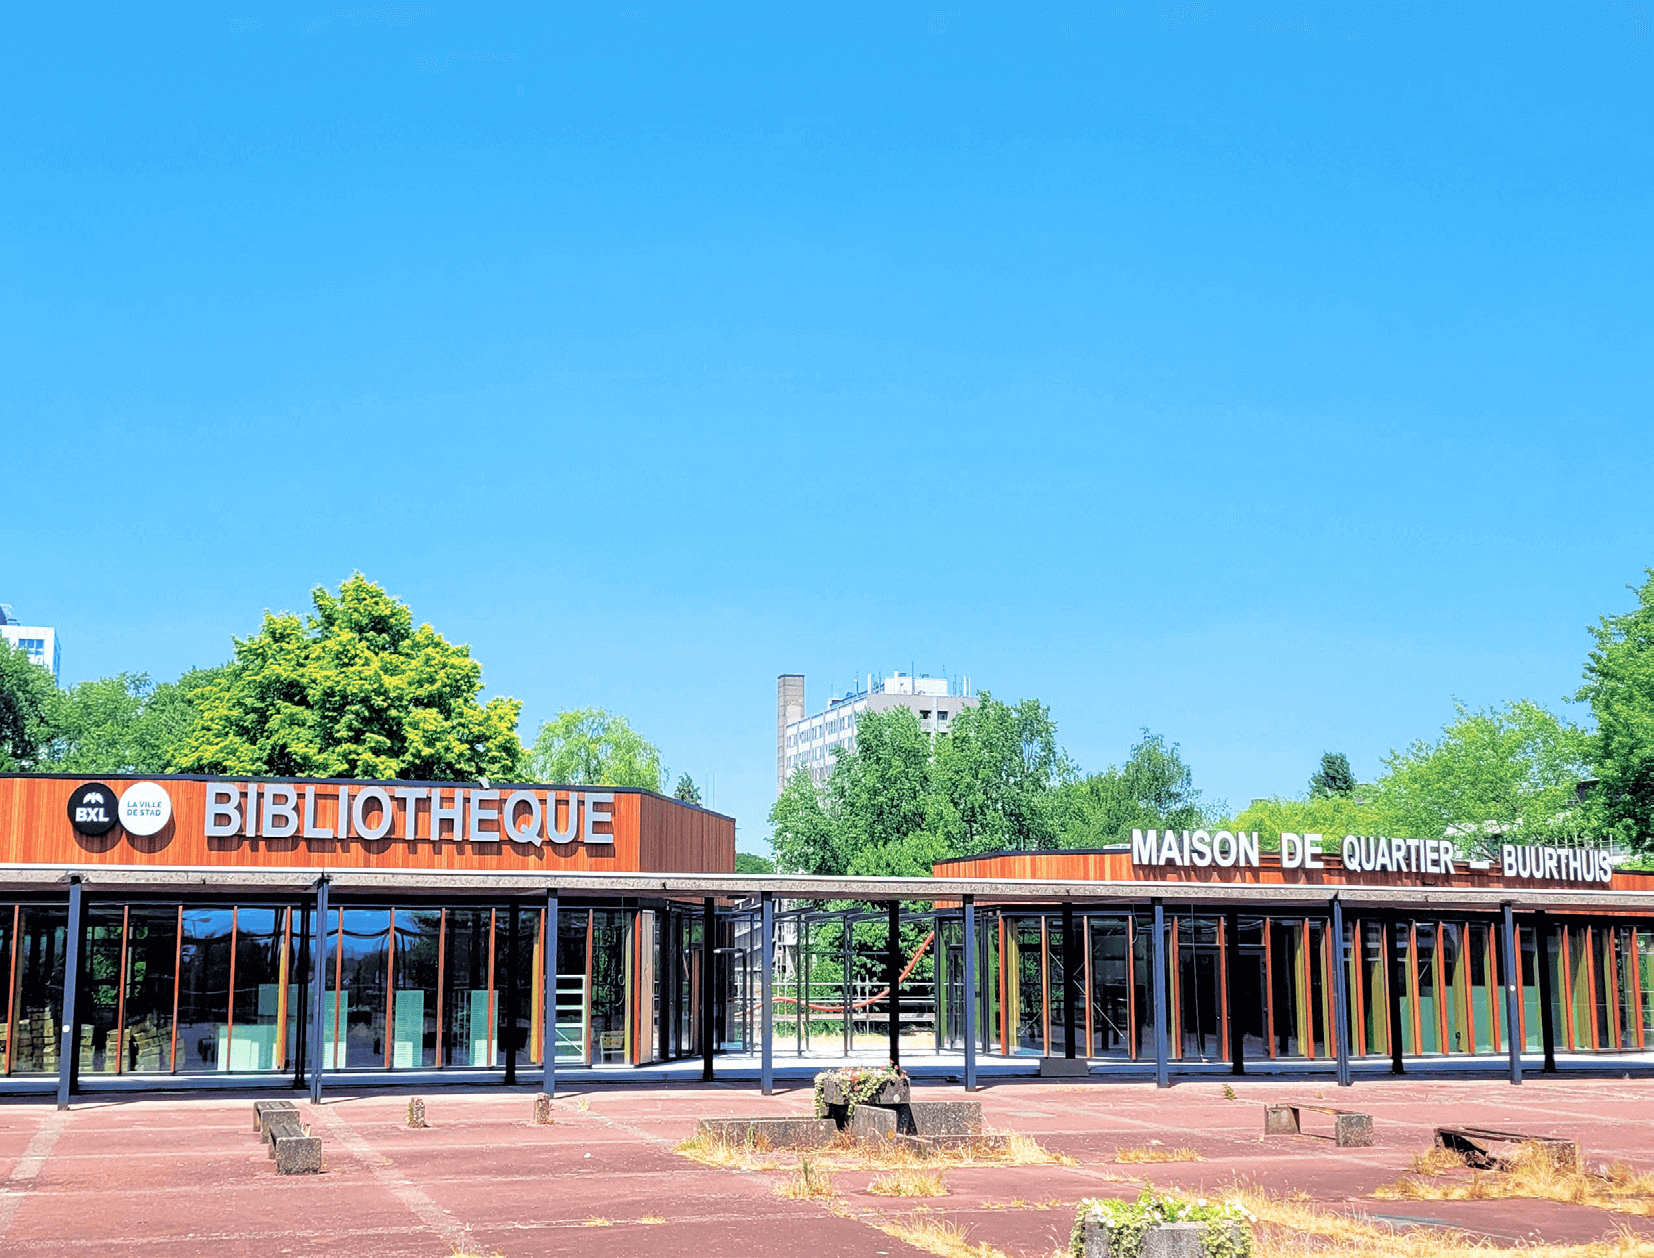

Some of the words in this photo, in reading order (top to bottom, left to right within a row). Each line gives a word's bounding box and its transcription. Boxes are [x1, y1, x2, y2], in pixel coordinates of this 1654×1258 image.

[75, 807, 110, 822] BXL
[204, 777, 614, 847] BIBLIOTHÈQUE
[1131, 828, 1260, 867] MAISON
[1281, 832, 1324, 869] DE
[1342, 835, 1456, 874] QUARTIER
[1503, 844, 1612, 882] BUURTHUIS
